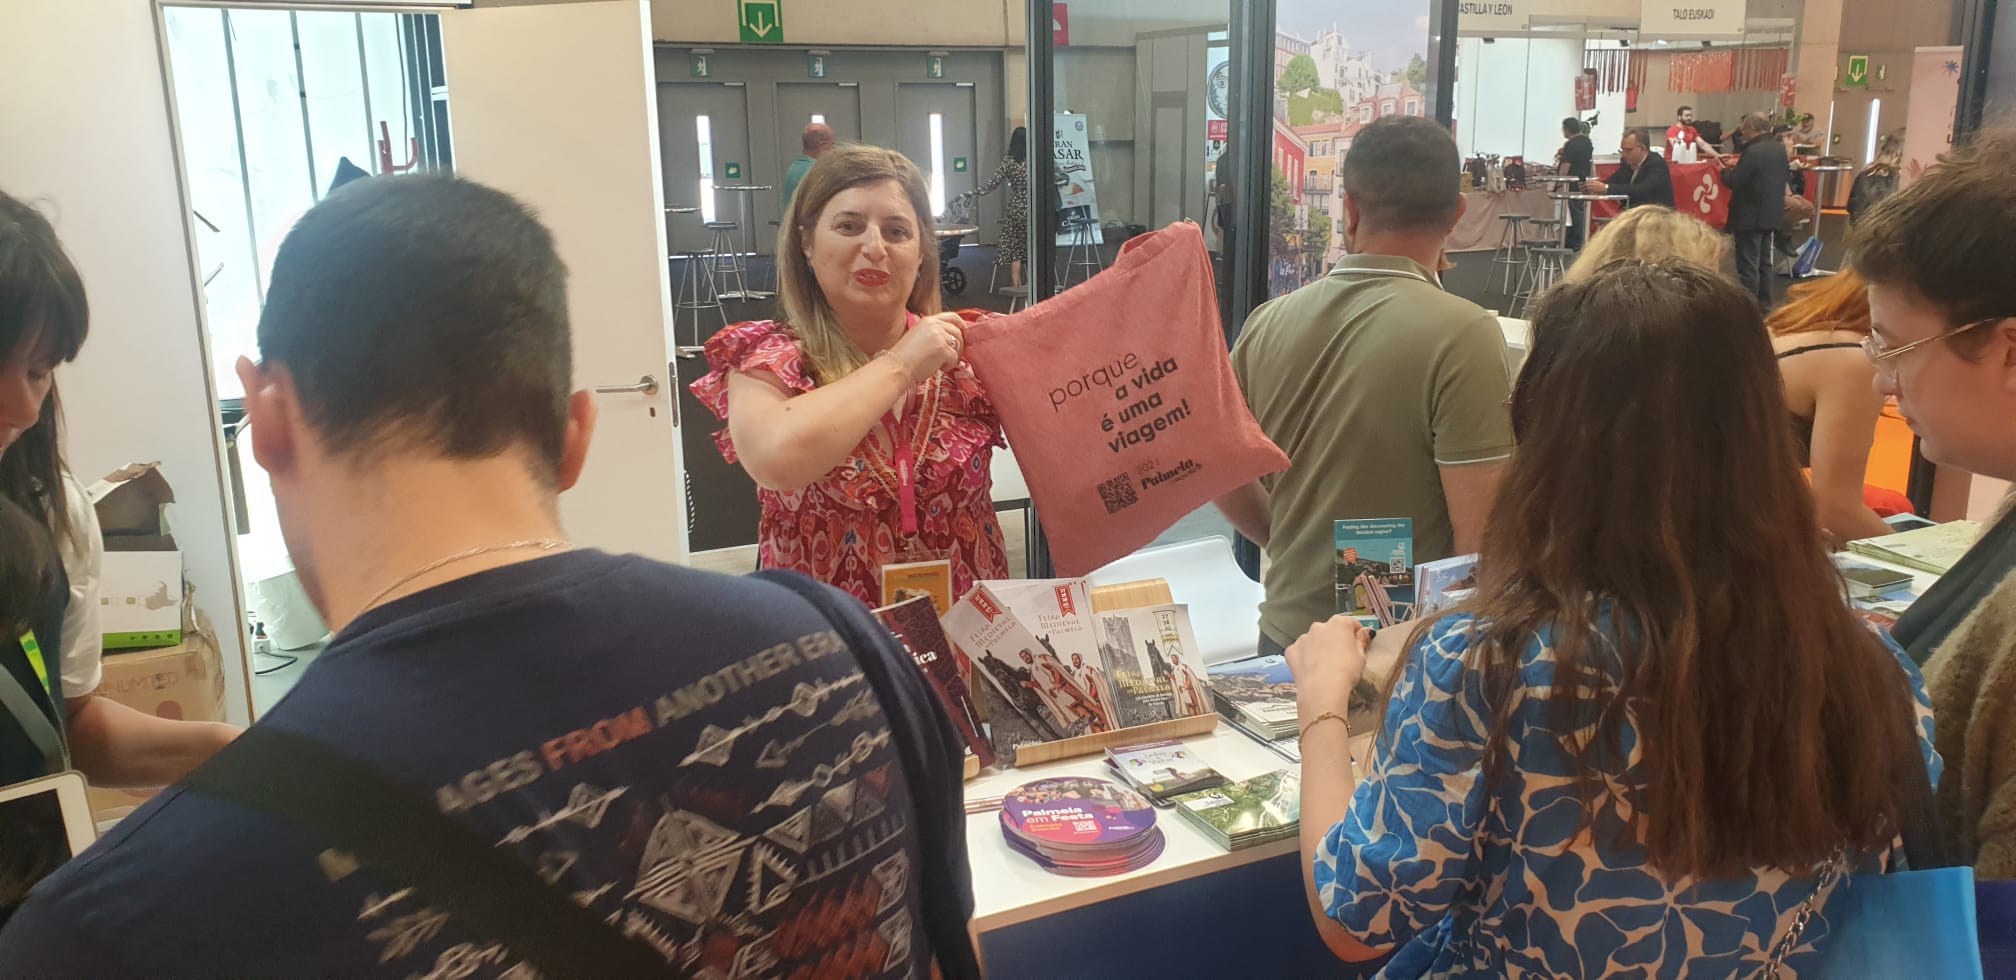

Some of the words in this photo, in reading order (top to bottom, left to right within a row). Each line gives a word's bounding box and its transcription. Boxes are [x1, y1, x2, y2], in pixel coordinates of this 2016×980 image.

[1459, 2, 1487, 15] ASTILLA
[1488, 3, 1494, 15] Y
[1673, 8, 1688, 20] TALO
[1689, 8, 1715, 20] EUSKADI
[1054, 149, 1084, 160] ASAR
[1055, 140, 1073, 148] RAN
[1048, 352, 1139, 413] porque
[1115, 385, 1129, 400] a
[1131, 357, 1179, 391] vida
[1100, 413, 1114, 432] é
[1118, 392, 1163, 423] uma
[1107, 398, 1191, 453] viagem!
[1140, 458, 1195, 490] Palmela
[436, 750, 544, 815] AGES
[540, 705, 653, 771] FROM
[654, 641, 800, 728] ANOTHER
[1021, 806, 1083, 817] Palmela
[1051, 813, 1094, 822] Festa
